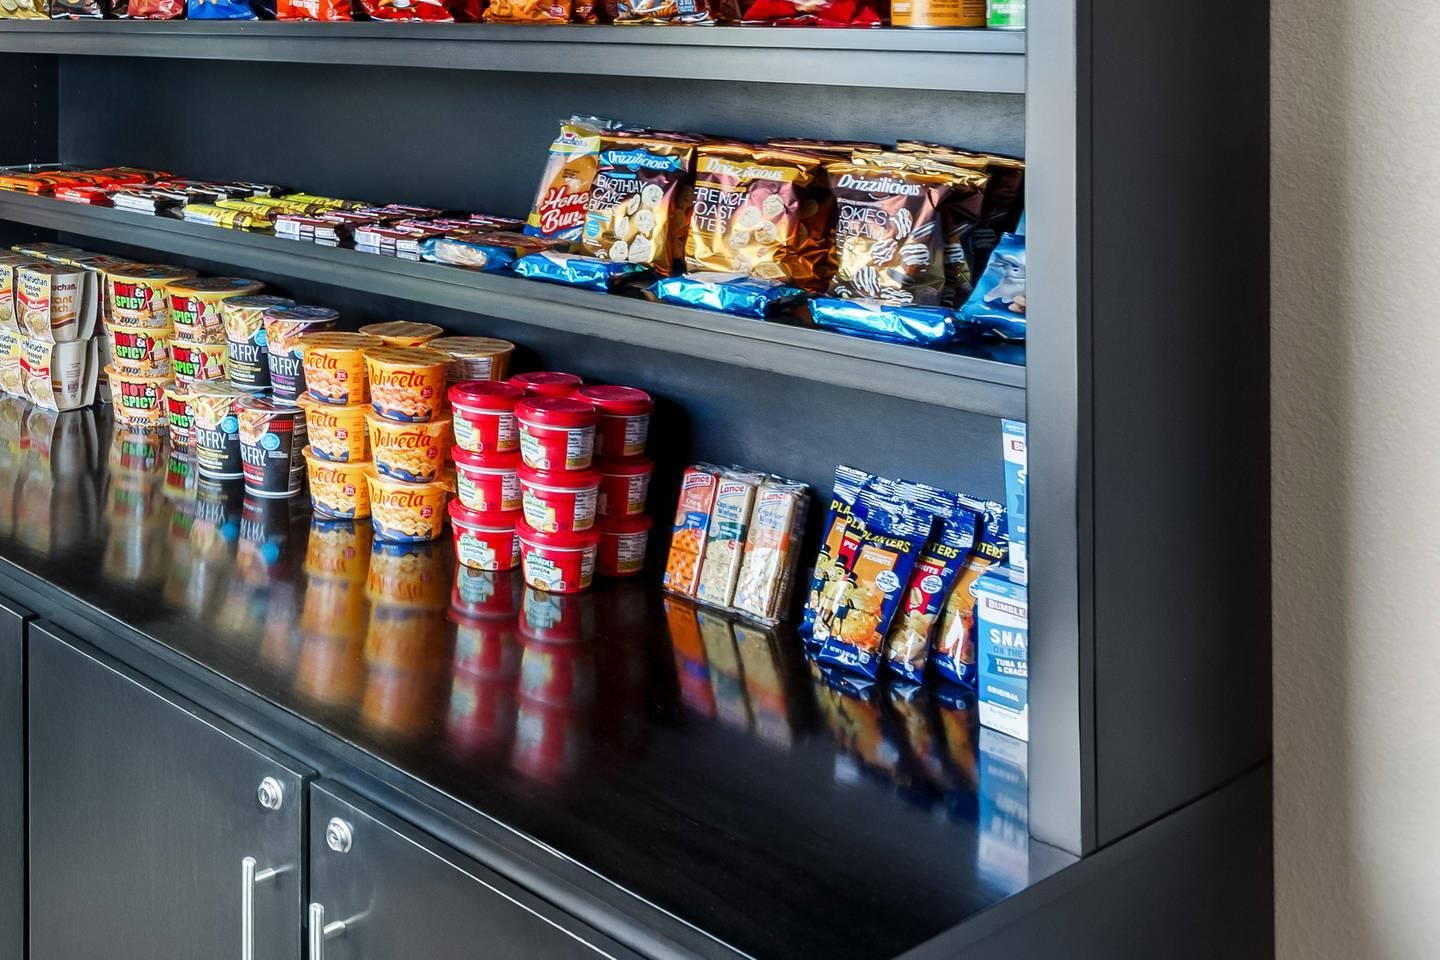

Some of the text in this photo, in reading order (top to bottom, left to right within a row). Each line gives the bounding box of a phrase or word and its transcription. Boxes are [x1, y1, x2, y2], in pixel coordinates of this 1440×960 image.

[609, 150, 671, 170] Drizzilicious
[706, 158, 784, 181] Drizzilicious
[596, 174, 648, 194] BIRTHDAY
[838, 174, 921, 195] Drizzilicious
[593, 188, 626, 203] CAKE
[114, 281, 134, 297] HOT
[115, 295, 145, 308] SPICY
[115, 332, 135, 347] HOT
[116, 345, 145, 359] SPICY
[279, 360, 299, 376] FRY
[121, 382, 144, 397] HOT
[122, 395, 155, 408] SPICY
[207, 431, 226, 449] FRY
[374, 432, 431, 448] Velveeta
[248, 448, 266, 466] FRY
[720, 485, 744, 493] Lance
[989, 600, 1025, 616] BUMBLE
[993, 646, 1024, 658] ON THE
[987, 685, 1019, 702] ORIGINAL
